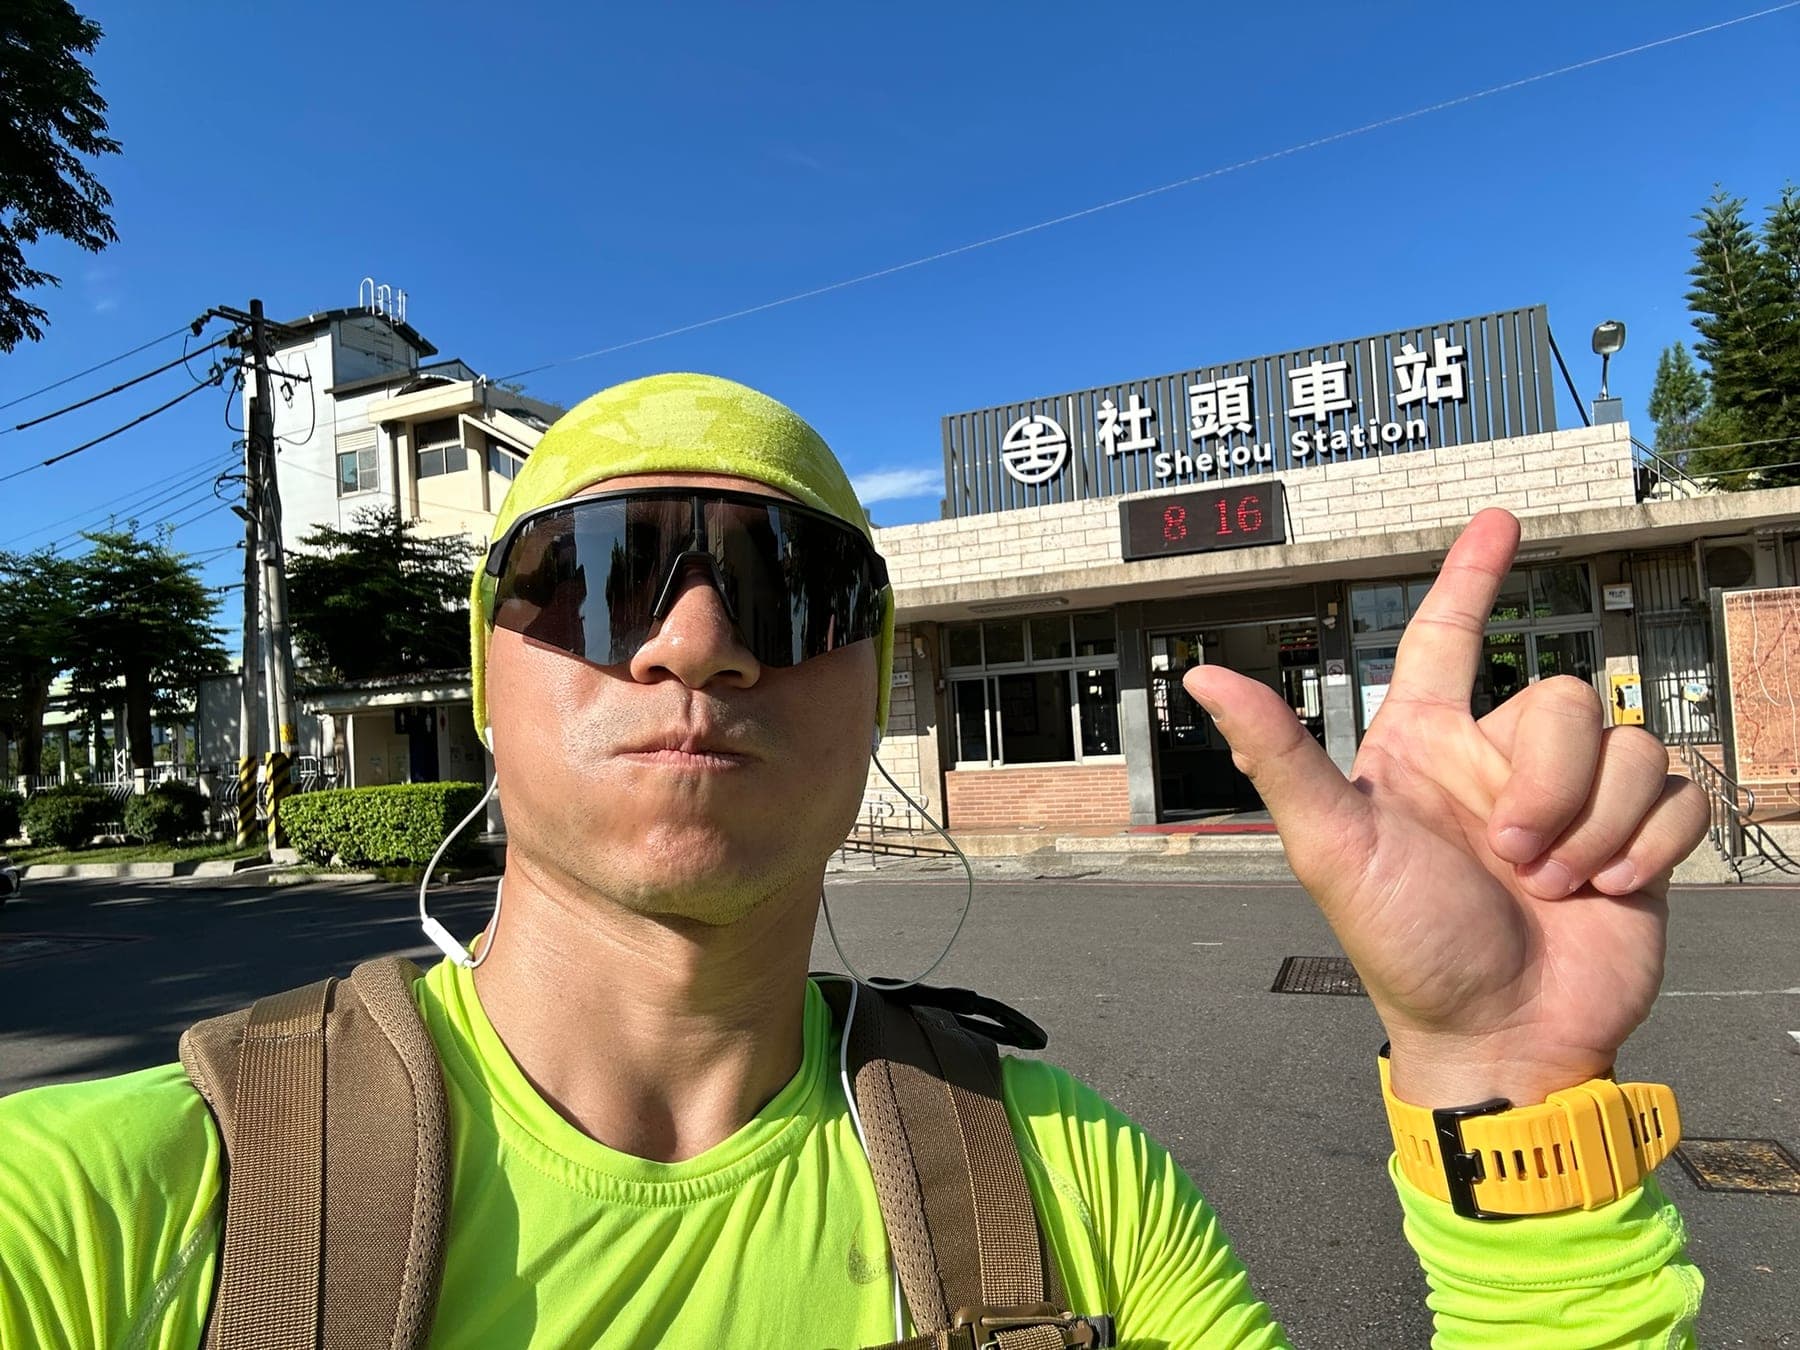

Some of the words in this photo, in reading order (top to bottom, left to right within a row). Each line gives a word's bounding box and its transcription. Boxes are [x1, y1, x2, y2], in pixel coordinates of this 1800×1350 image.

[1097, 337, 1464, 456] 社頭車站
[1155, 442, 1272, 479] Shetou
[1291, 417, 1427, 458] Station
[1162, 505, 1188, 541] 8
[1214, 495, 1264, 536] 16
